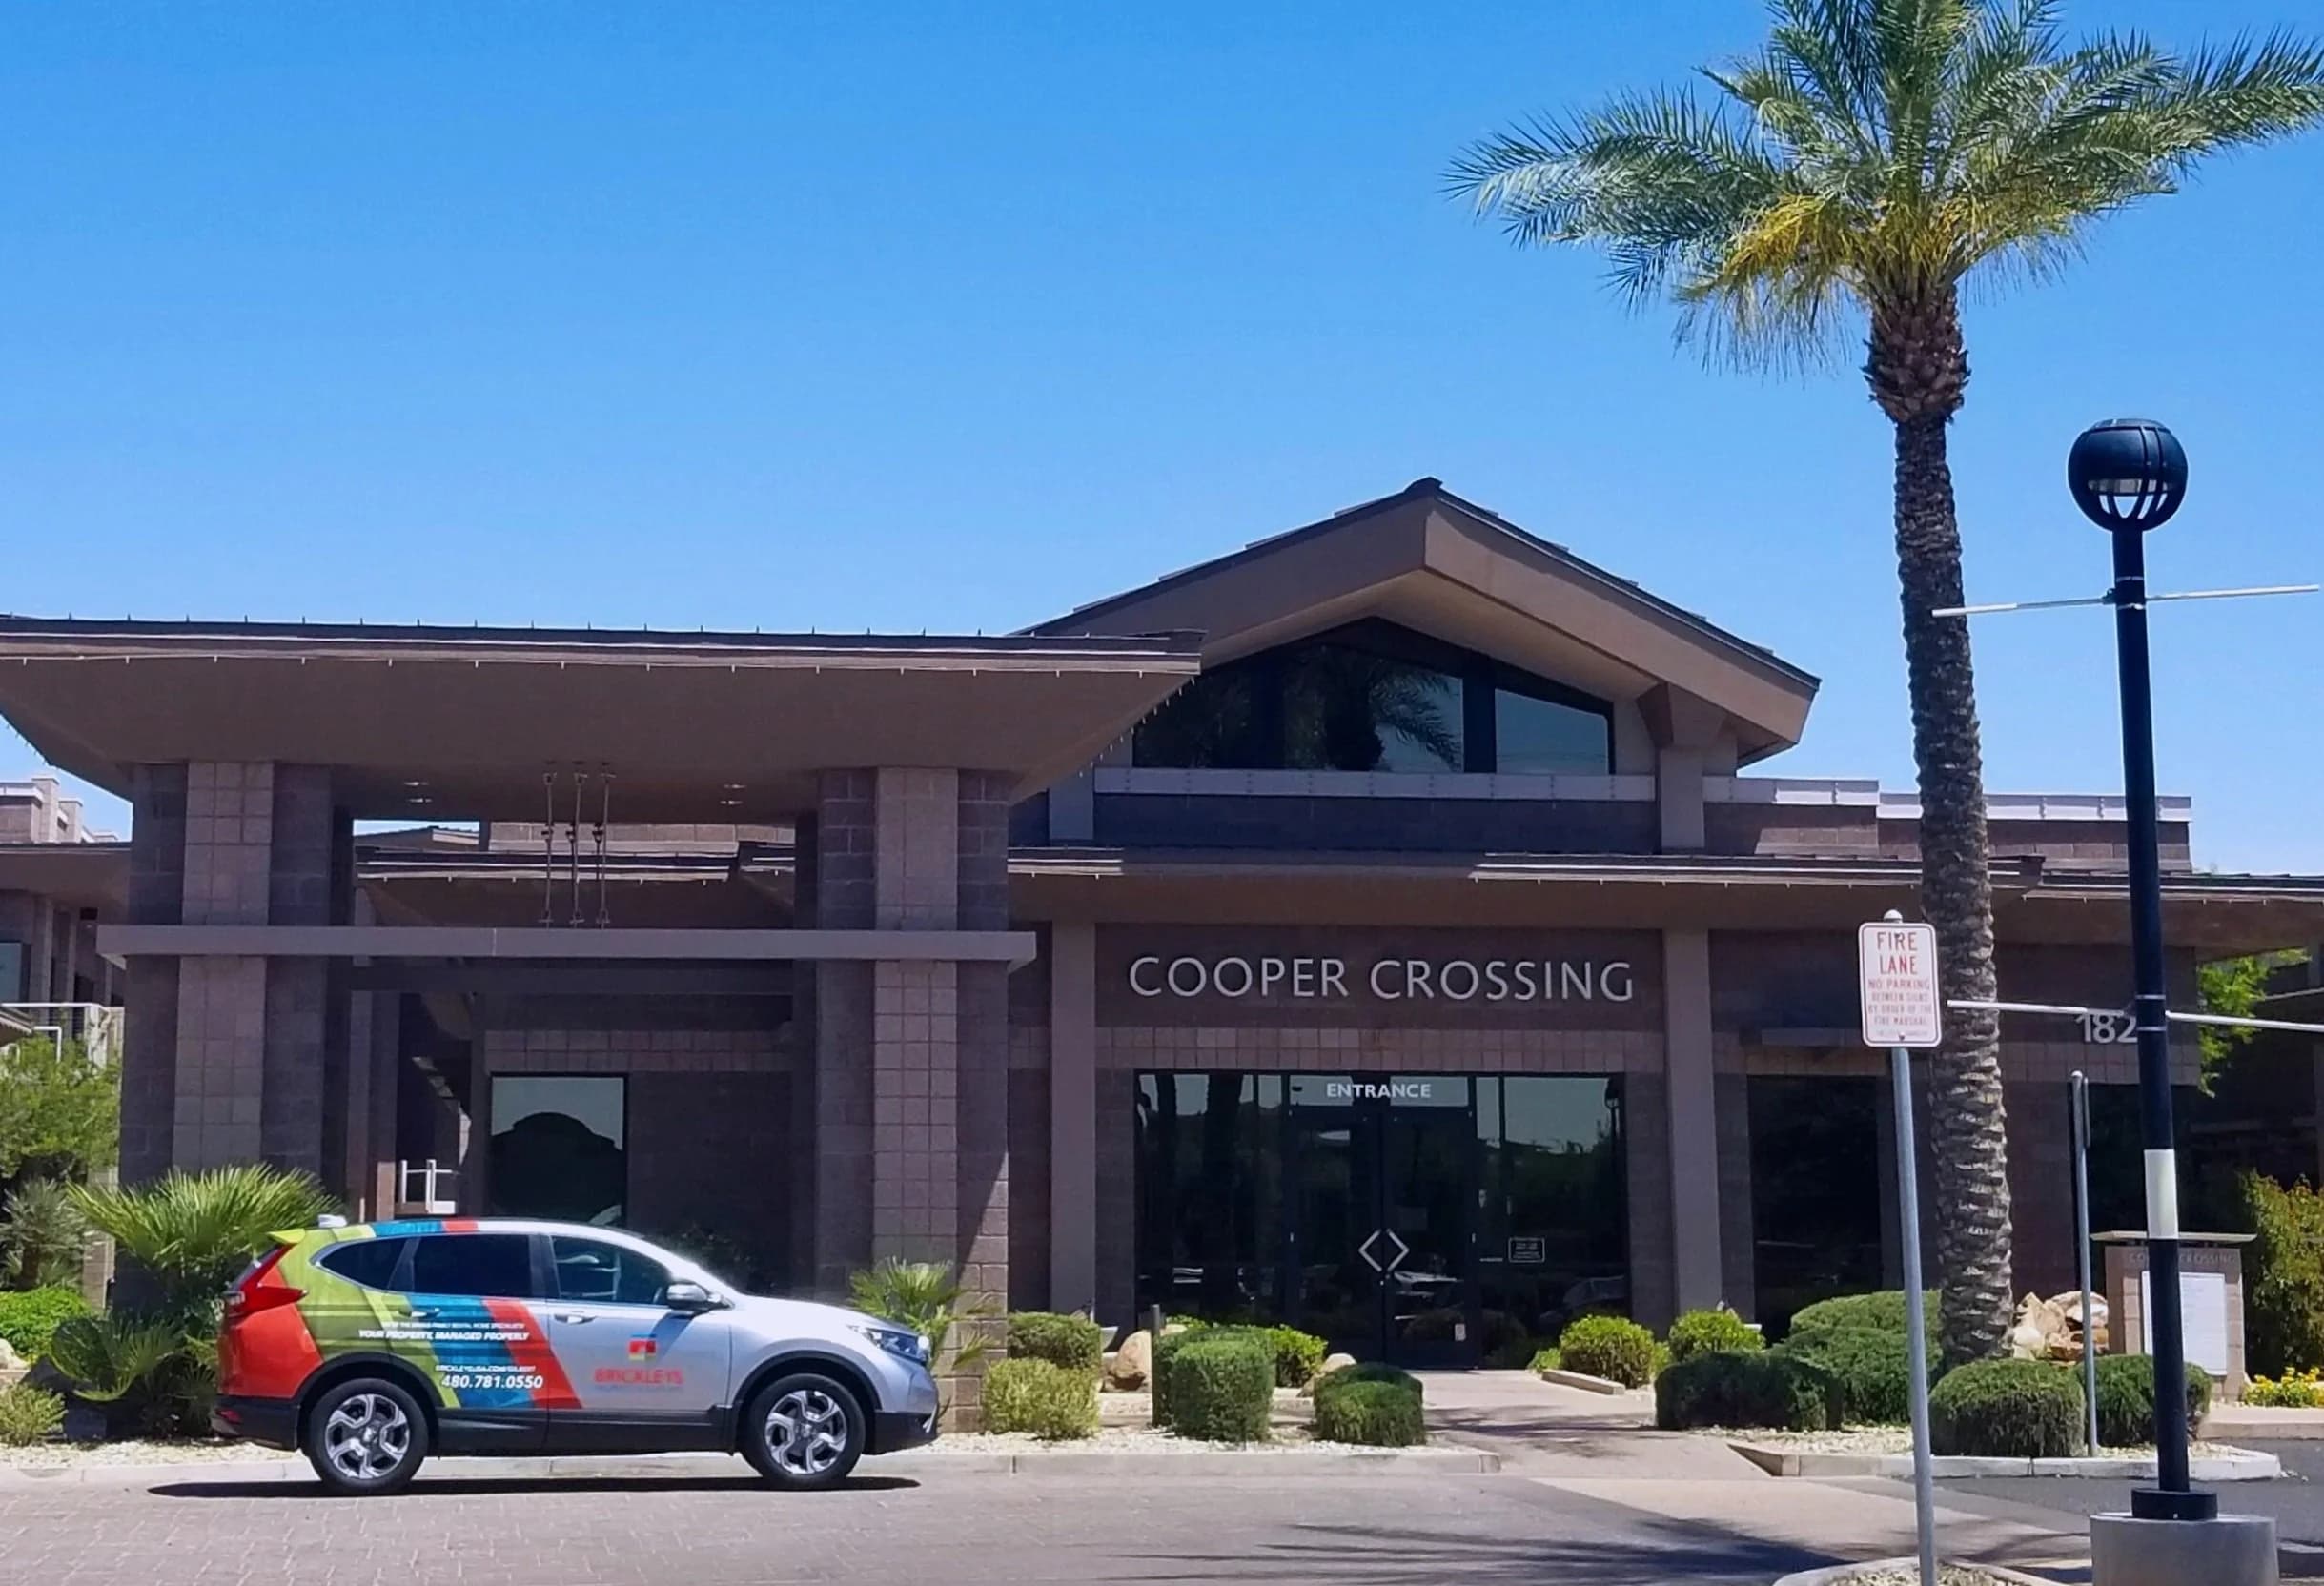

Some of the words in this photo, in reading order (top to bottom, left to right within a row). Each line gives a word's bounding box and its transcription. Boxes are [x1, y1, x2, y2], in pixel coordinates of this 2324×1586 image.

[1877, 931, 1917, 951] FIRE
[1880, 955, 1917, 974] LANE
[1129, 957, 1349, 998] COOPER
[1369, 960, 1634, 1002] CROSSING
[1868, 979, 1883, 989] NO
[1886, 979, 1930, 990] PARKING
[1326, 1083, 1432, 1099] ENTRANCE
[358, 1330, 384, 1338] YOUR
[435, 1332, 482, 1340] MANAGED
[484, 1332, 530, 1341] PROPERLY
[441, 1375, 544, 1389] 480.781.0550
[594, 1368, 683, 1385] BRICKLEYS
